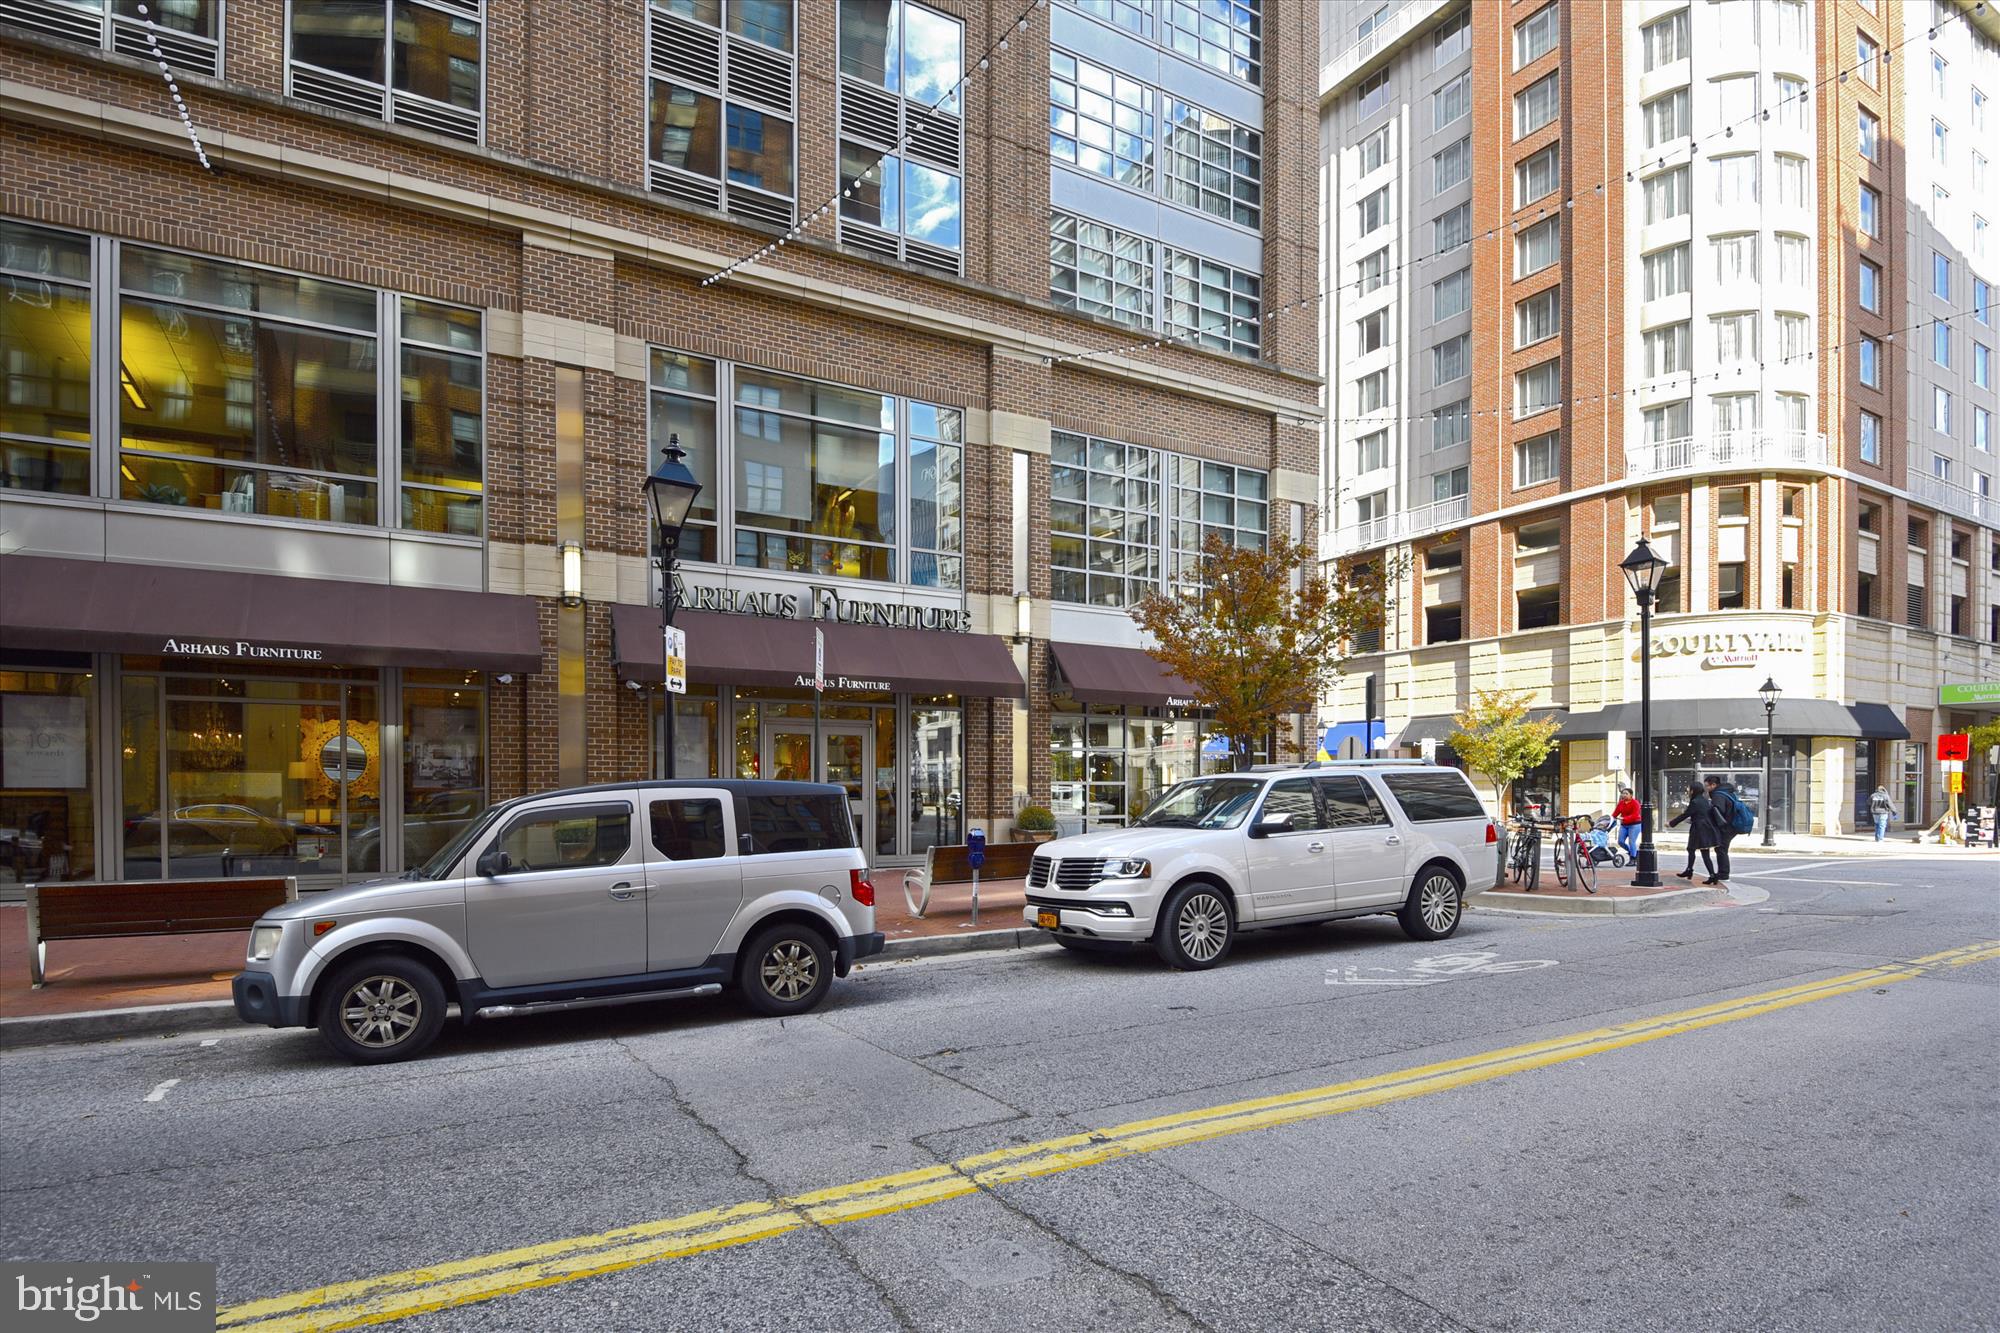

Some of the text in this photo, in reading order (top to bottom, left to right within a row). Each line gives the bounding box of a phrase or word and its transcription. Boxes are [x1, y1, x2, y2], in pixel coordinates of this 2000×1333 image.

[808, 585, 972, 633] FURNITURE
[163, 638, 322, 660] ARHAUS FURNITURE
[794, 674, 891, 691] ARHUS FURNITURE
[1720, 727, 1769, 735] MAC
